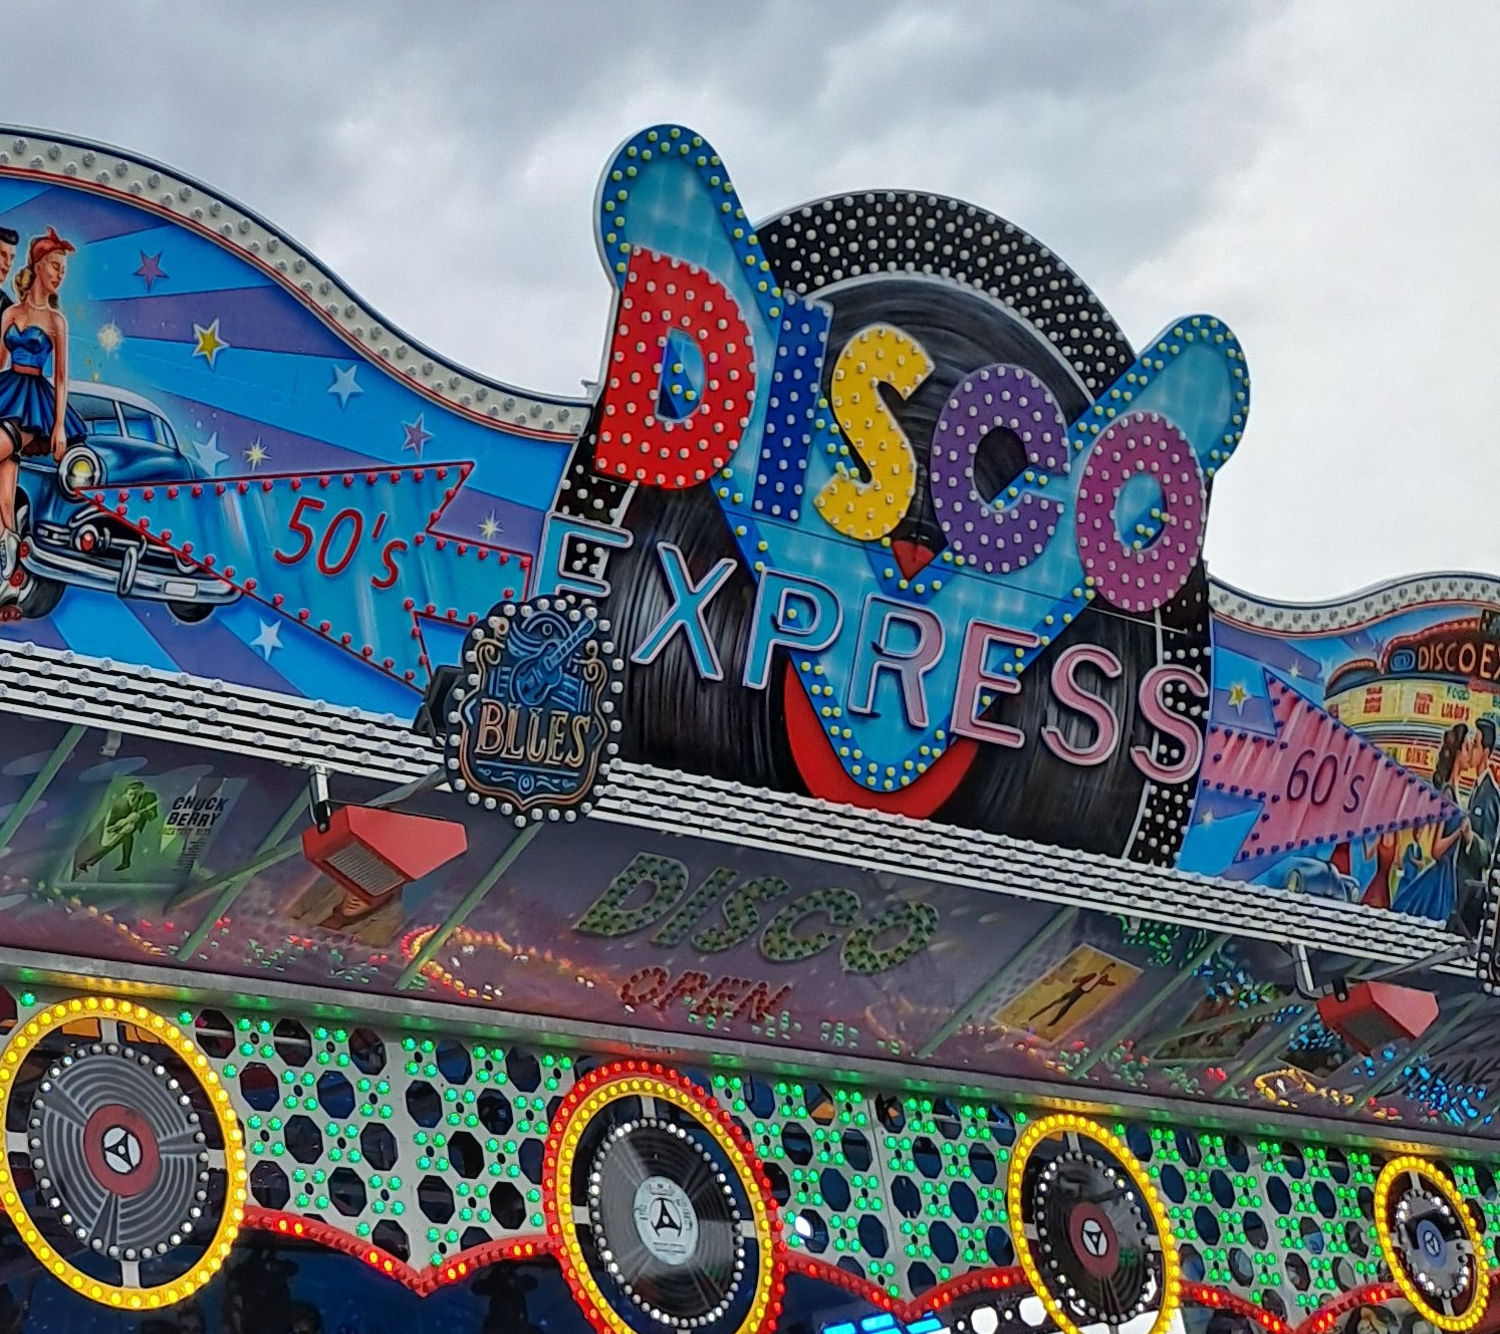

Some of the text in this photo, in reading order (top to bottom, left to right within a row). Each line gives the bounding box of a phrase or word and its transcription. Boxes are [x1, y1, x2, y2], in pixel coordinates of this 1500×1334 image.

[594, 244, 1206, 613] DISCO
[273, 496, 409, 589] 50's
[530, 512, 1211, 785] EXPRESS
[1417, 640, 1477, 673] DISCO
[473, 698, 592, 767] BLUES
[172, 795, 229, 812] CHUCK
[1286, 749, 1365, 814] 60's
[167, 812, 222, 828] BERRY
[571, 851, 941, 975] DISCO
[616, 966, 792, 1021] OPEN
